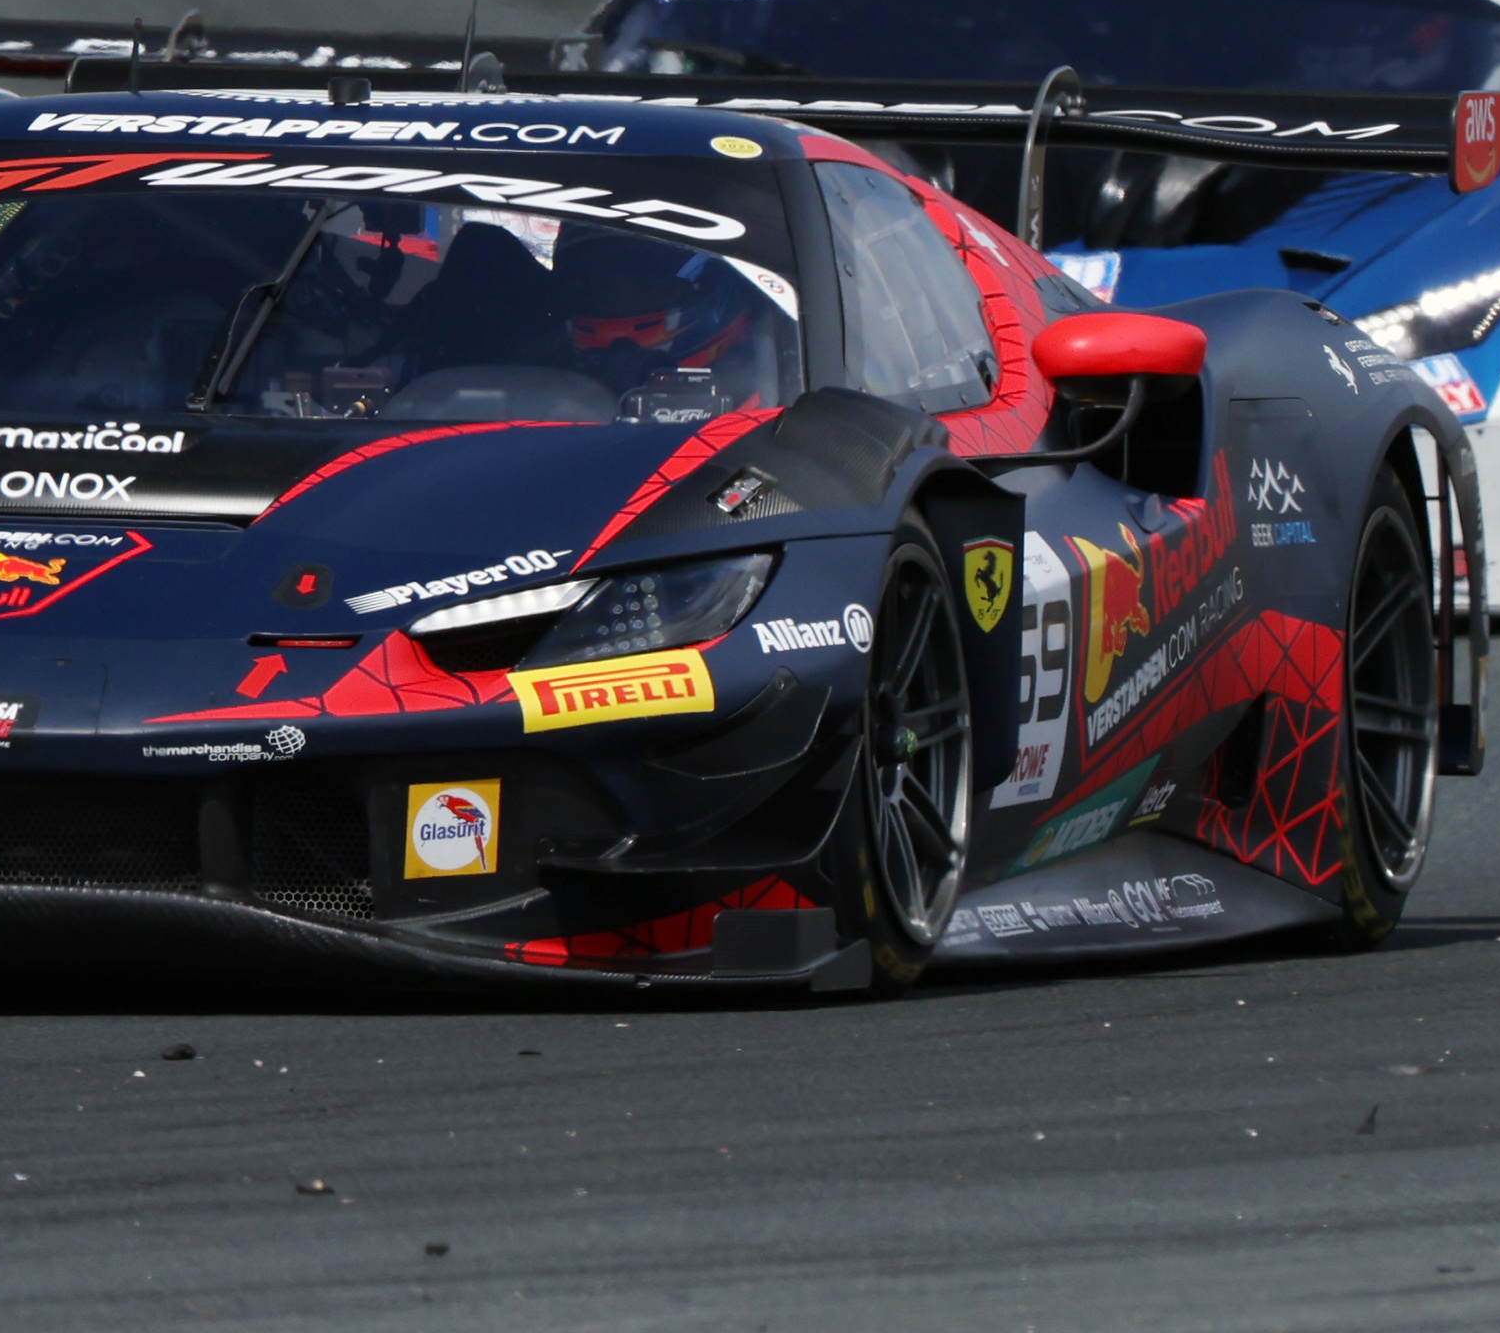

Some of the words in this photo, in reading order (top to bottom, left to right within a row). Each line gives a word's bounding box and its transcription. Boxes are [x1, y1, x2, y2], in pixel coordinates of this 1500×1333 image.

[27, 112, 627, 145] VERSTAPPEN.COM
[1464, 96, 1496, 143] aws
[140, 162, 746, 241] WORLD
[752, 616, 846, 654] Allianz
[532, 662, 696, 717] PIRELLI
[142, 742, 262, 757] themerchandise
[420, 819, 486, 842] Glasurit
